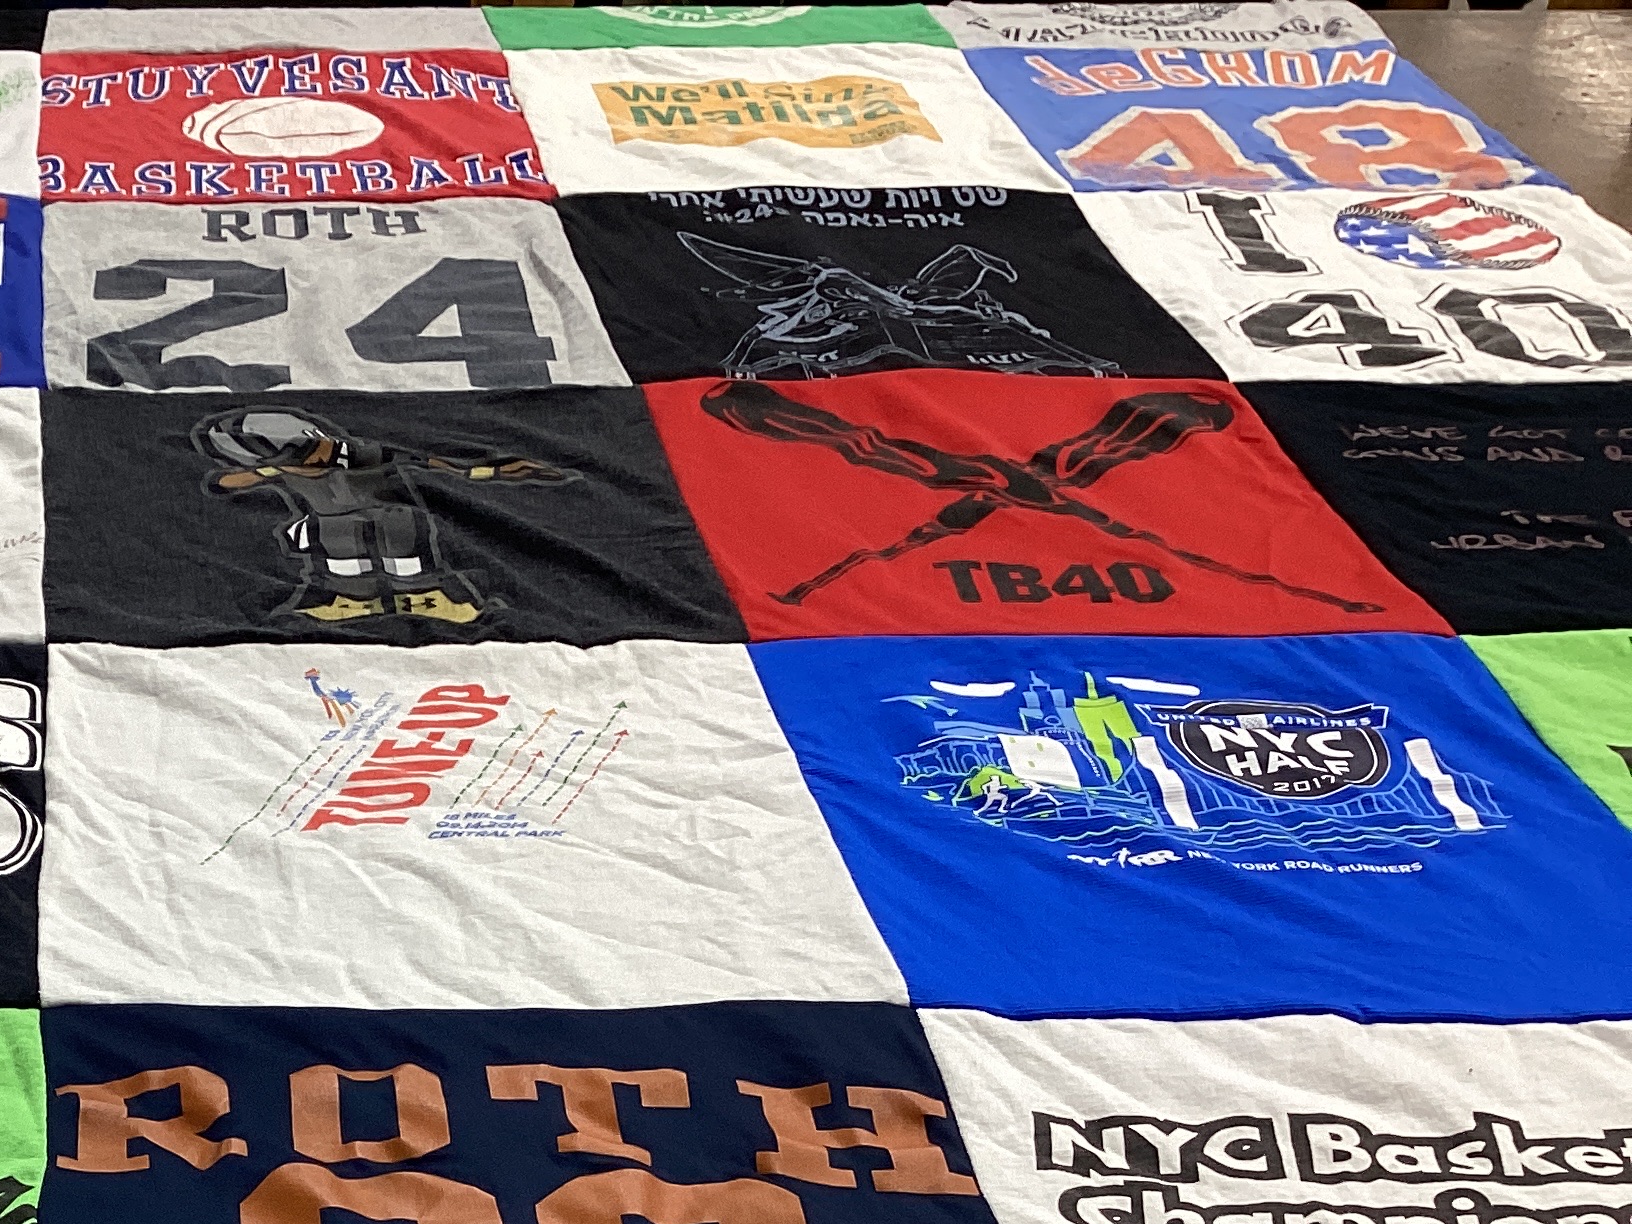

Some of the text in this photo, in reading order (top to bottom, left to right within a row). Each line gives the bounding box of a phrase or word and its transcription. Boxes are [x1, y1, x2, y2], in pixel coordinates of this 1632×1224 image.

[40, 53, 521, 112] STUYVESANT
[610, 80, 748, 102] We'll
[1058, 100, 1536, 191] 48
[202, 205, 426, 242] ROTH
[86, 258, 556, 390] 24
[1226, 283, 1632, 367] 40
[932, 560, 1176, 605] TB40
[1273, 715, 1372, 727] AIRLINES
[1200, 724, 1354, 759] NYC
[1226, 751, 1351, 777] HALF
[1272, 775, 1340, 792] 2017
[463, 812, 517, 820] MILES
[428, 830, 566, 839] CENTRAL PARK
[1284, 861, 1333, 873] ROAD
[1338, 862, 1423, 873] RUNNERS
[55, 1063, 981, 1196] ROTH
[1033, 1111, 1283, 1180] NYC
